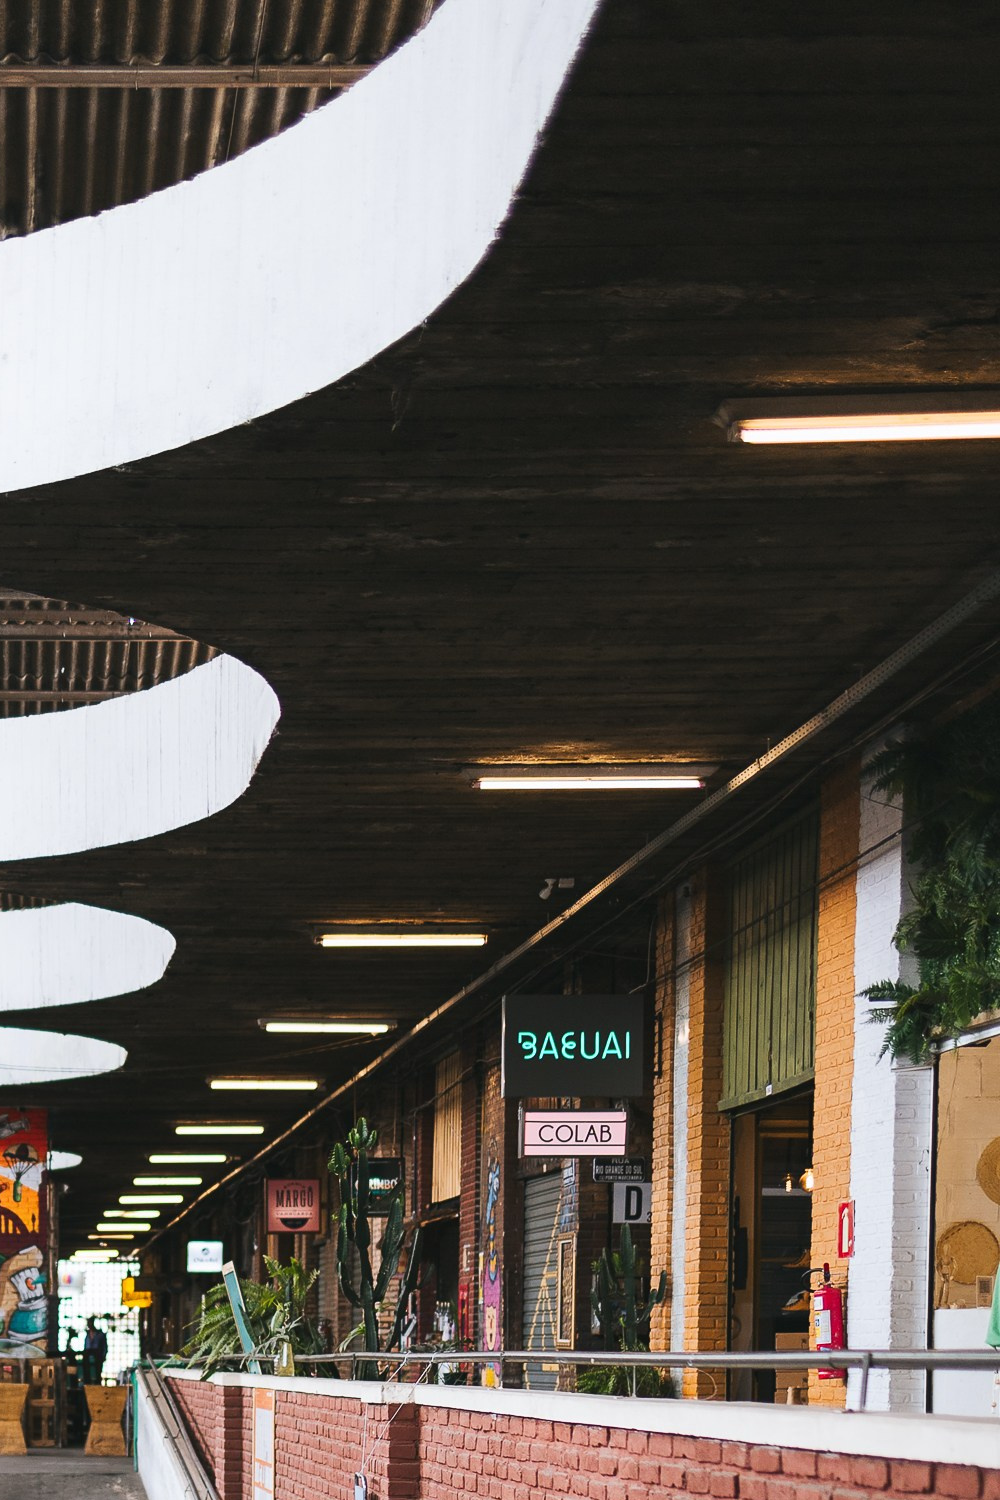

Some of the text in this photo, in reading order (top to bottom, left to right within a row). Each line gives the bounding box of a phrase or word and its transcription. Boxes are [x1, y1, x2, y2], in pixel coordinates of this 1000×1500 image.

[538, 1124, 612, 1143] COLAB
[595, 1165, 643, 1175] RIO GRANDE DO SUL
[276, 1185, 314, 1208] MARGÔ
[624, 1185, 643, 1221] D
